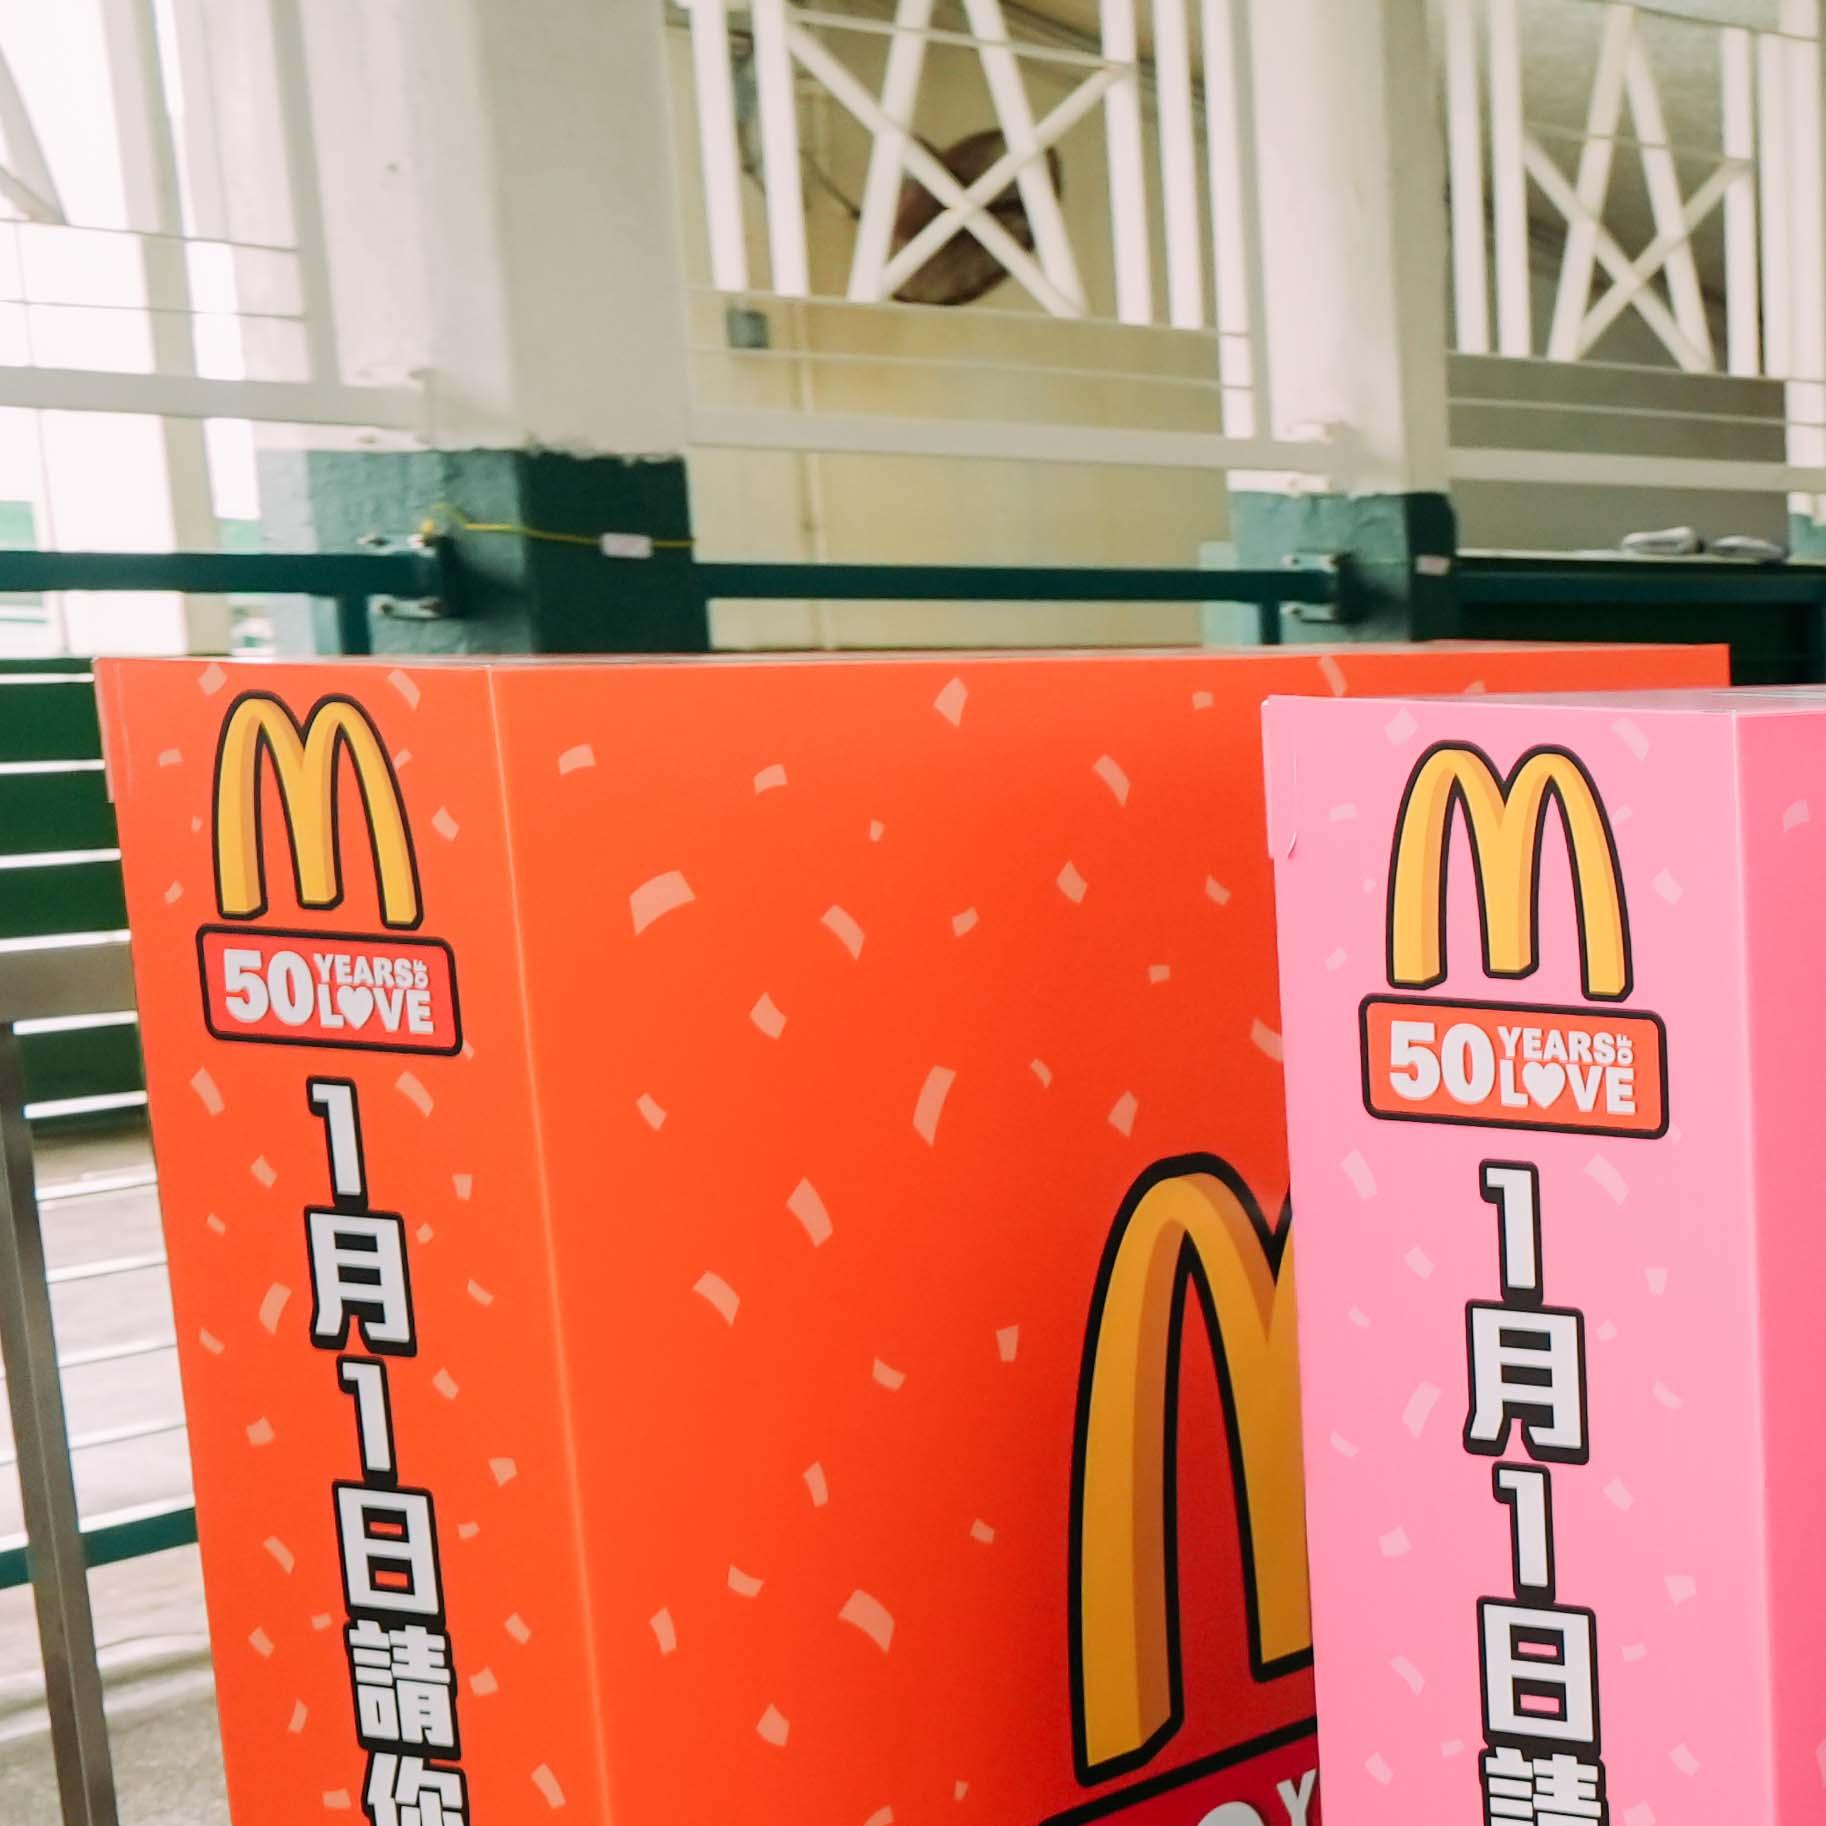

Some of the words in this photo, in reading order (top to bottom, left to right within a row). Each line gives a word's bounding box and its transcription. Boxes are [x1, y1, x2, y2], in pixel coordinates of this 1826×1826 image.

[224, 948, 314, 1026] 50
[313, 953, 414, 988] YEARS
[414, 960, 429, 990] OF
[1389, 1020, 1496, 1105] 50
[1497, 1025, 1617, 1065] YEARS
[1616, 1034, 1633, 1067] OF
